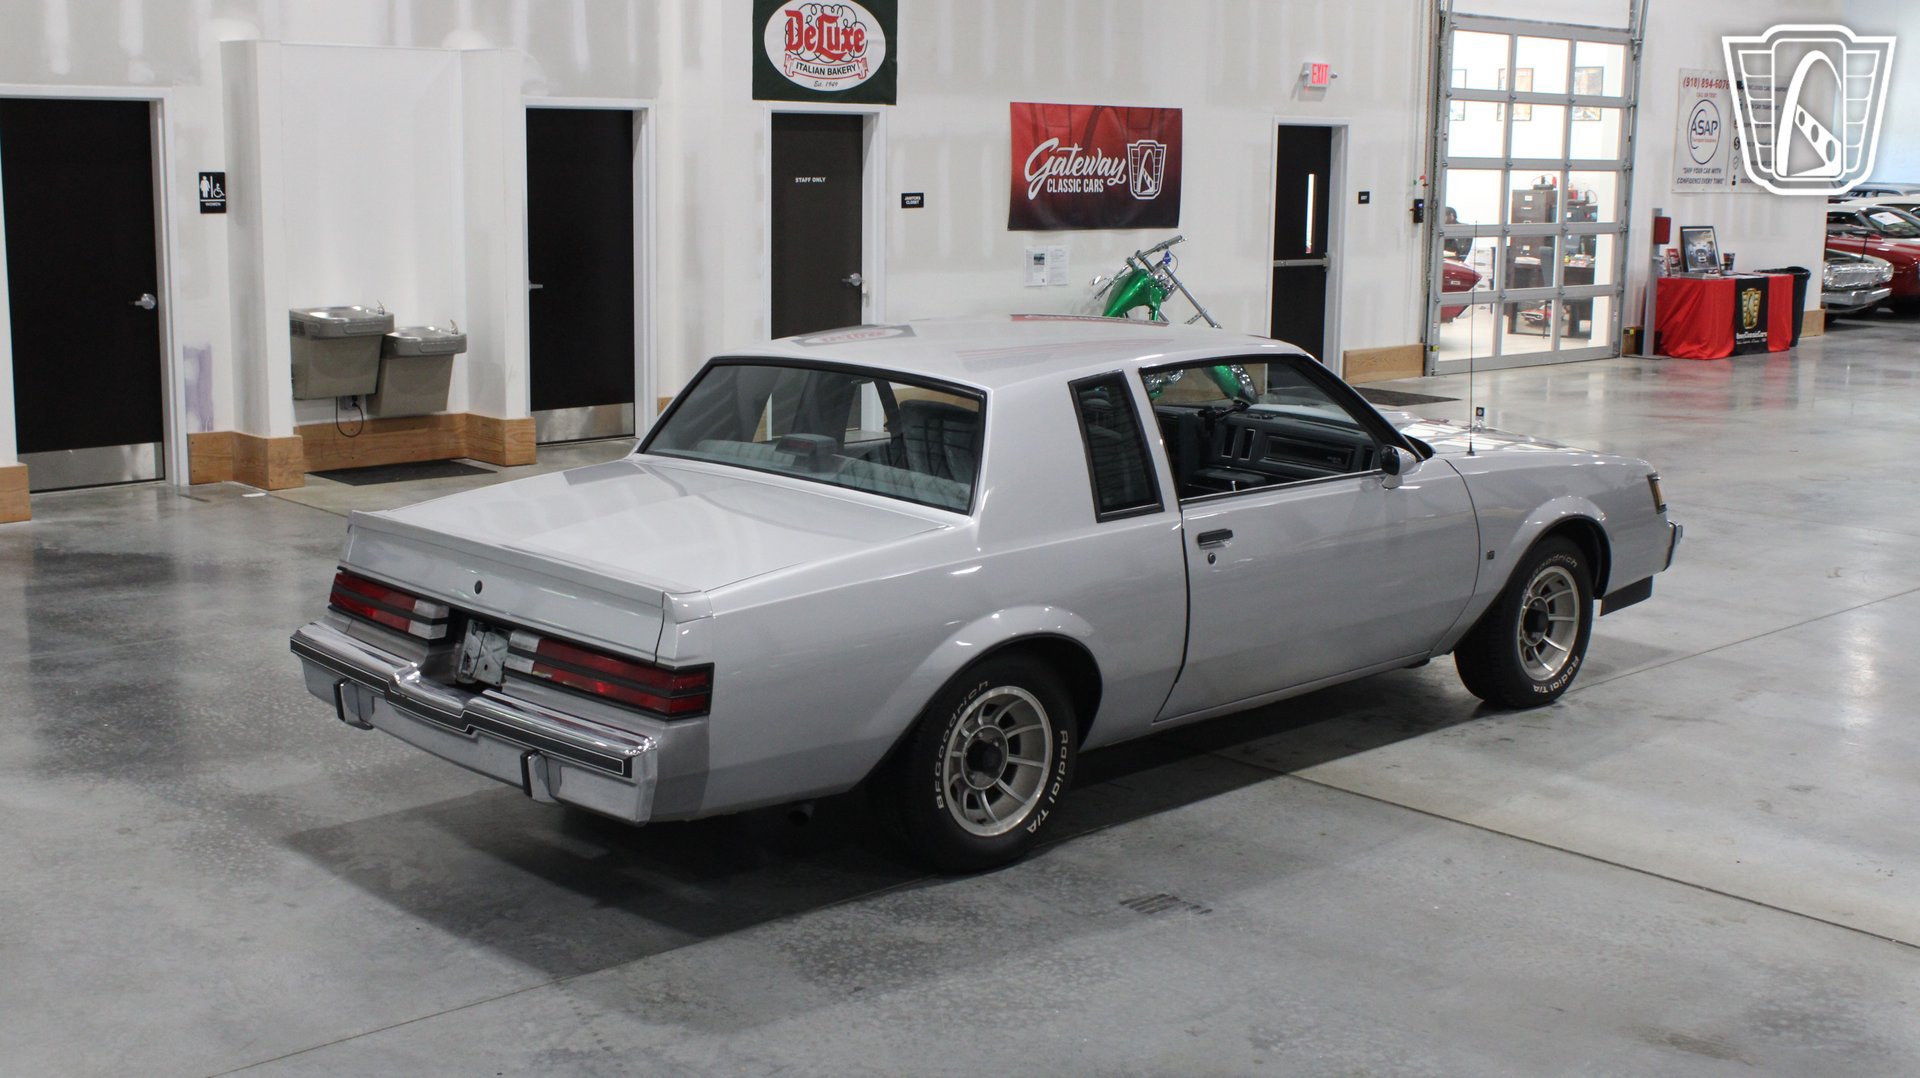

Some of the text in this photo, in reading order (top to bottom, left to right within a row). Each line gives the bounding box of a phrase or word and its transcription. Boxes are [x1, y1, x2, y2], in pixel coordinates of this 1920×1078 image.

[785, 10, 865, 61] DeLuxe
[796, 62, 856, 75] ITALIAN BAKERY
[1311, 63, 1329, 85] EXIT
[1691, 120, 1718, 136] ASAP
[1024, 137, 1126, 200] Gateway
[1047, 178, 1104, 193] CLASSIC CARS
[1550, 655, 1579, 692] Radial
[935, 681, 988, 809] BFGoodrich
[1027, 730, 1068, 833] Radial T/A
